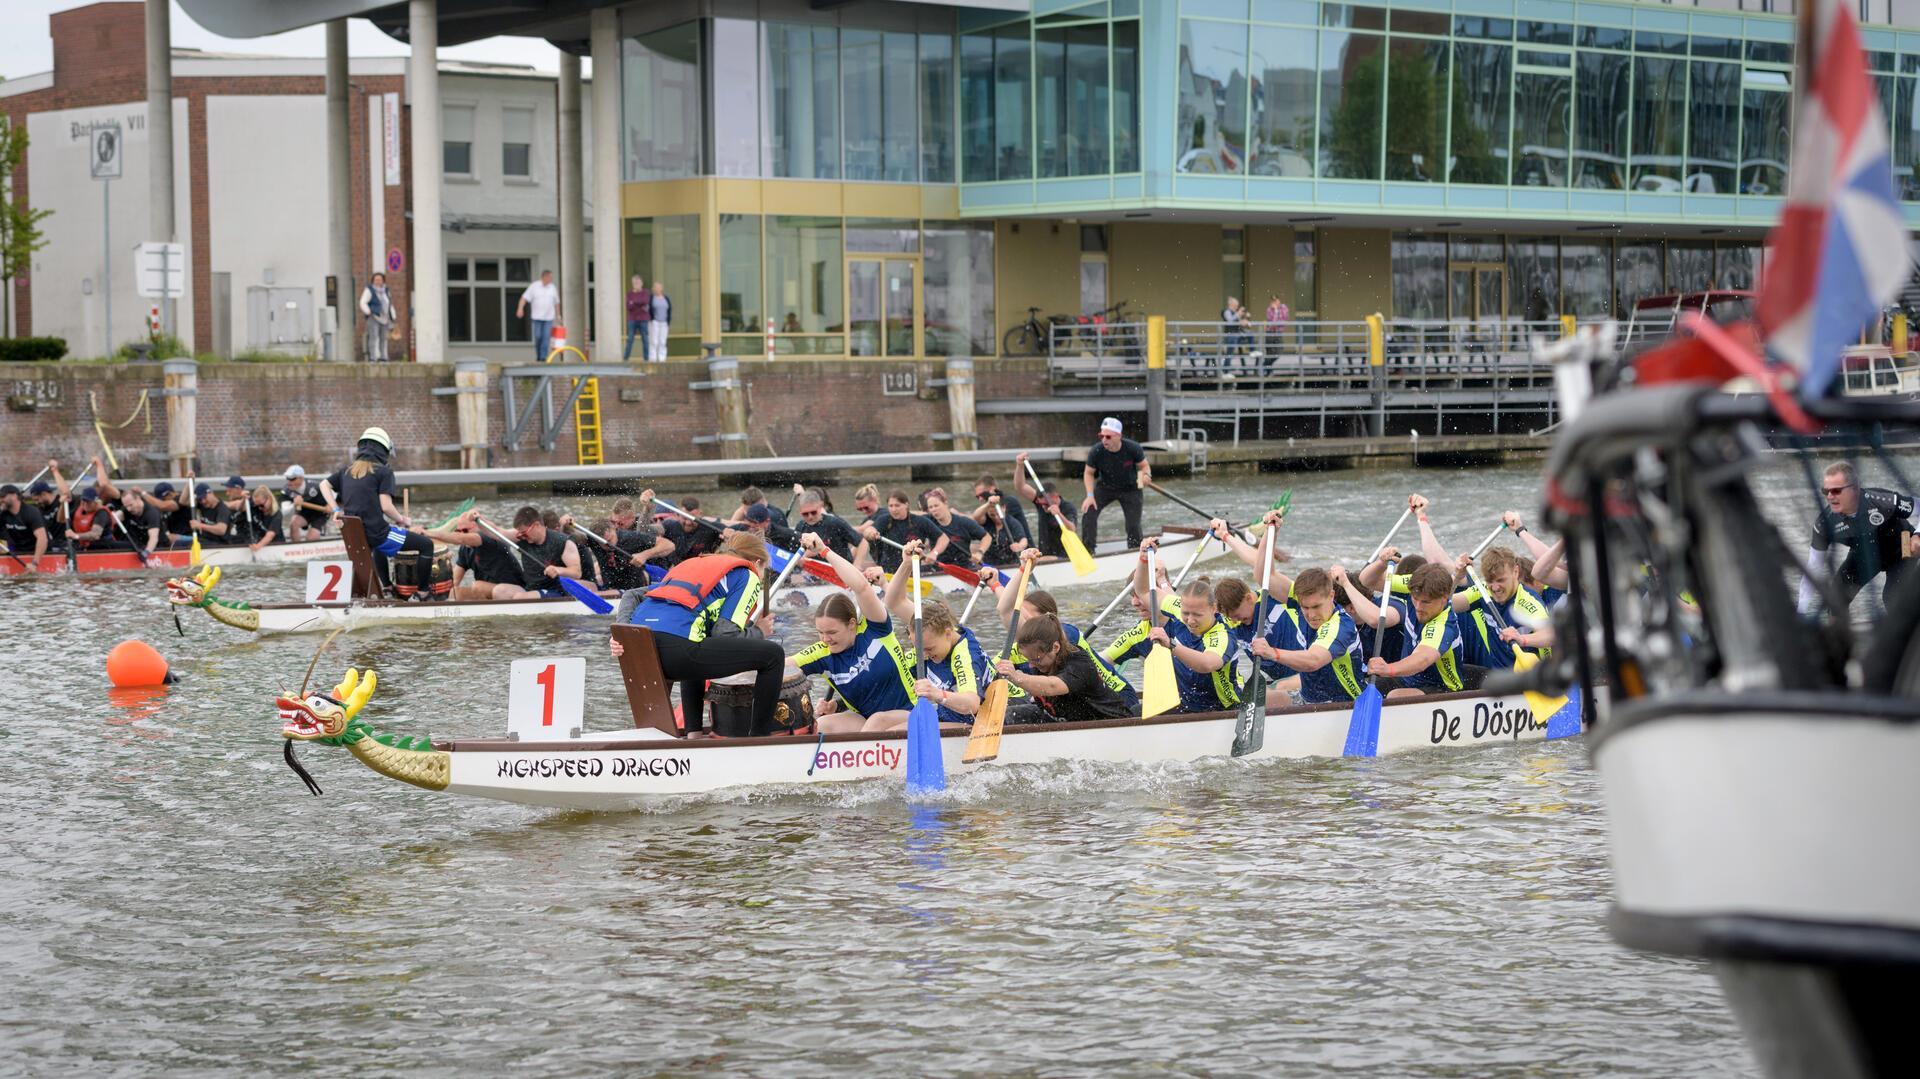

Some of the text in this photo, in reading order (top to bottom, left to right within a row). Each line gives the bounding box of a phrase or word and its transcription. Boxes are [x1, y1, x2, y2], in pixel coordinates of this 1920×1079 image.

[126, 114, 145, 131] VII
[316, 565, 343, 601] 2
[744, 582, 761, 615] OLIZEI
[1517, 597, 1538, 614] OLIZEI
[1114, 626, 1144, 649] POLIZEI
[893, 645, 915, 688] BREMER
[954, 654, 968, 686] POLIZEI
[537, 664, 556, 727] 1
[1431, 702, 1549, 744] De Dösp
[496, 757, 691, 778] HIGHSPEED DRAGON
[815, 742, 901, 770] enercity
